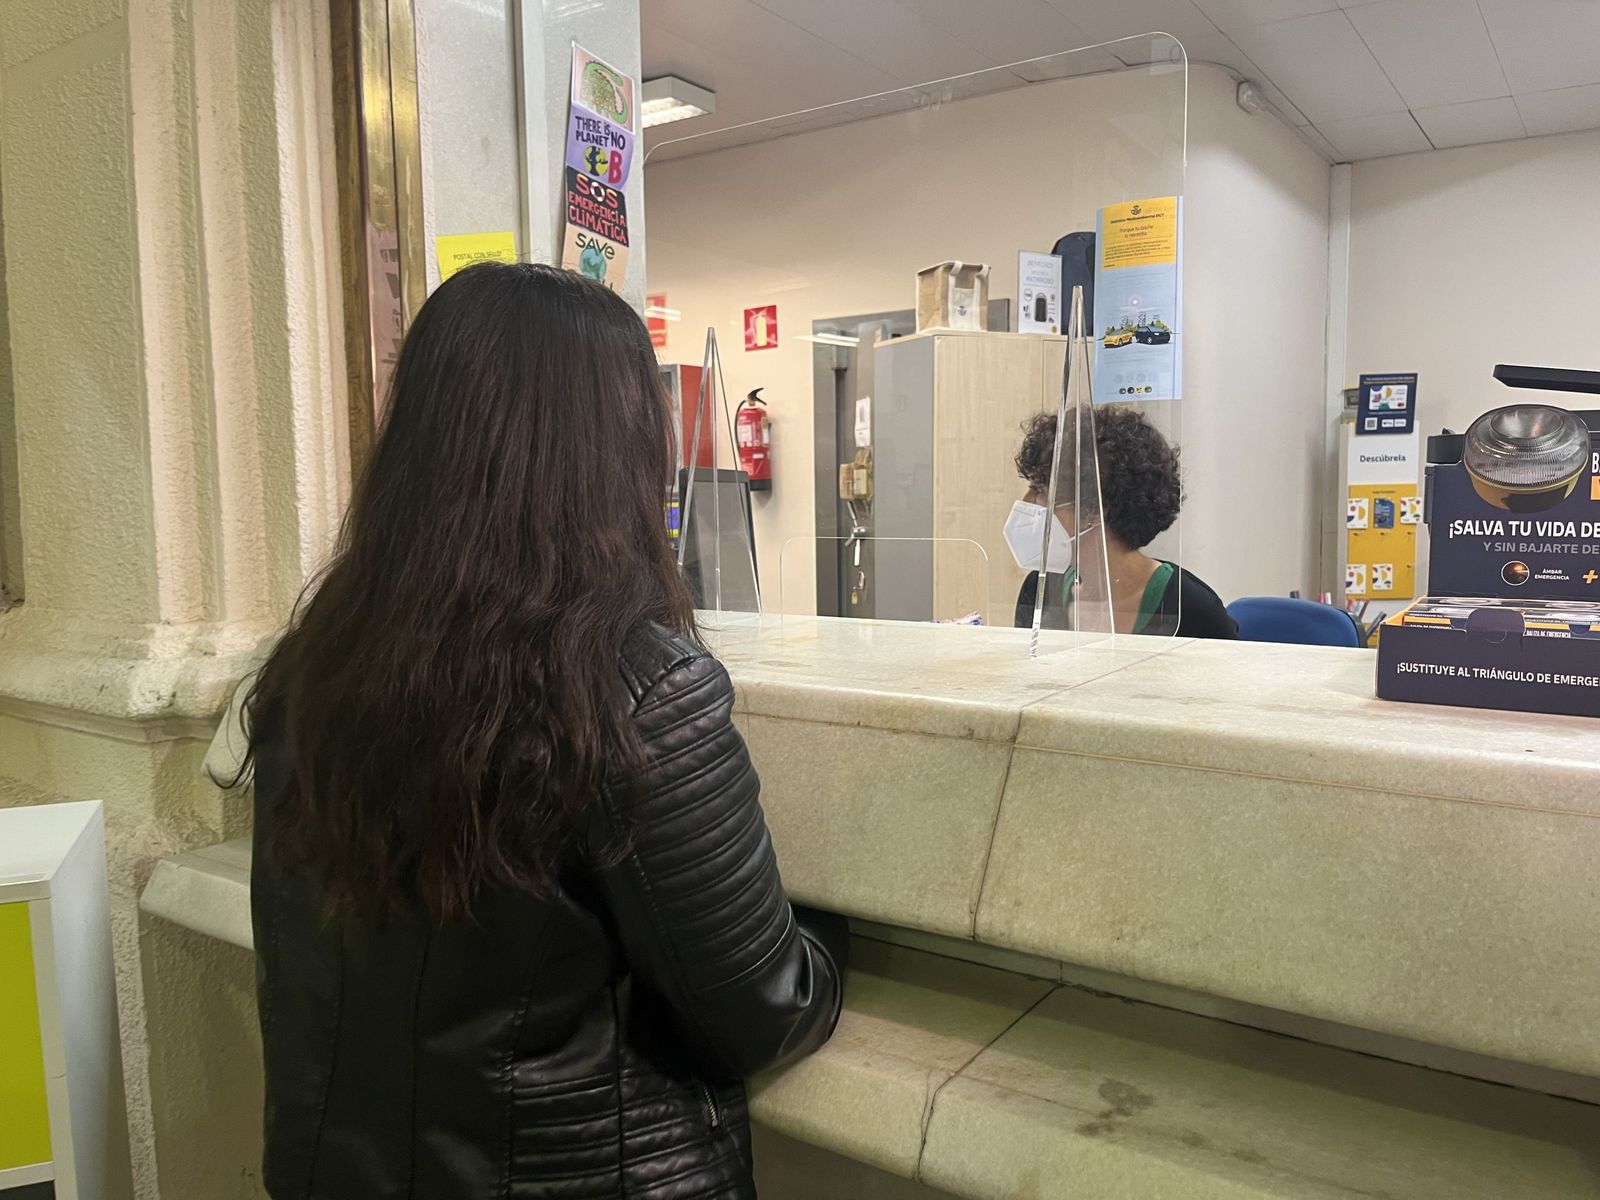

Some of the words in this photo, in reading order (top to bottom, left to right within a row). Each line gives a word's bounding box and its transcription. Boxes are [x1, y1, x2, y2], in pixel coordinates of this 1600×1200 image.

[575, 115, 602, 134] THERE
[611, 131, 626, 150] NO
[575, 130, 609, 147] PLANET
[608, 150, 623, 184] B
[575, 173, 618, 209] SOS
[1360, 453, 1406, 463] Descúbrela
[1449, 520, 1504, 539] ¡SALVA
[1508, 520, 1532, 536] TU
[1535, 521, 1577, 538] VIDA
[1483, 541, 1492, 551] Y
[1494, 542, 1515, 552] SIN
[1519, 543, 1579, 554] BAJARTE
[1397, 662, 1455, 676] ¡SUSTITUYE
[1457, 668, 1470, 677] AL
[1472, 667, 1534, 682] TRIÁNGULO
[1537, 673, 1551, 684] DE
[1553, 674, 1600, 687] EMERGE
